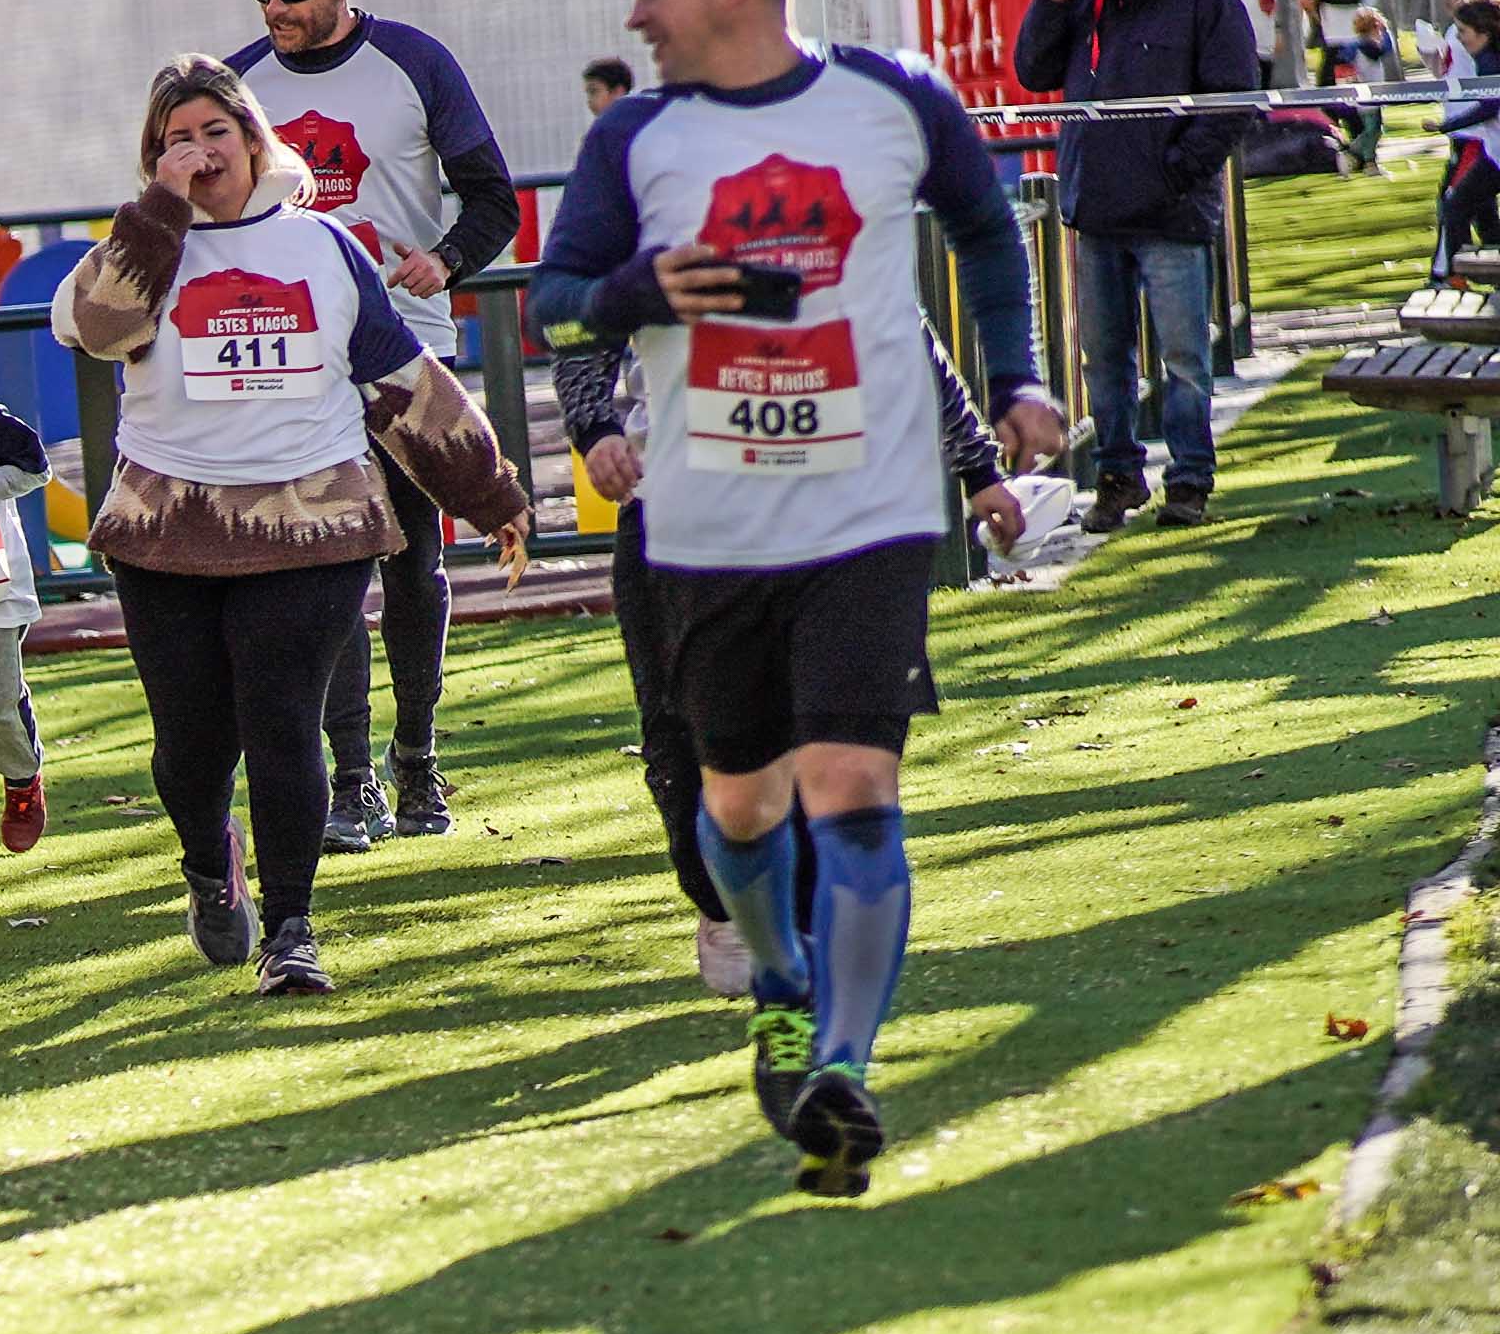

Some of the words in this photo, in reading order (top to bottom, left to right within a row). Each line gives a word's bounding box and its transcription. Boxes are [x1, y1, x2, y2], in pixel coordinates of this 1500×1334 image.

[207, 318, 248, 334] REYES
[252, 314, 298, 333] MAGOS
[218, 337, 286, 368] 411
[768, 367, 828, 394] MAGOS
[729, 399, 819, 437] 408
